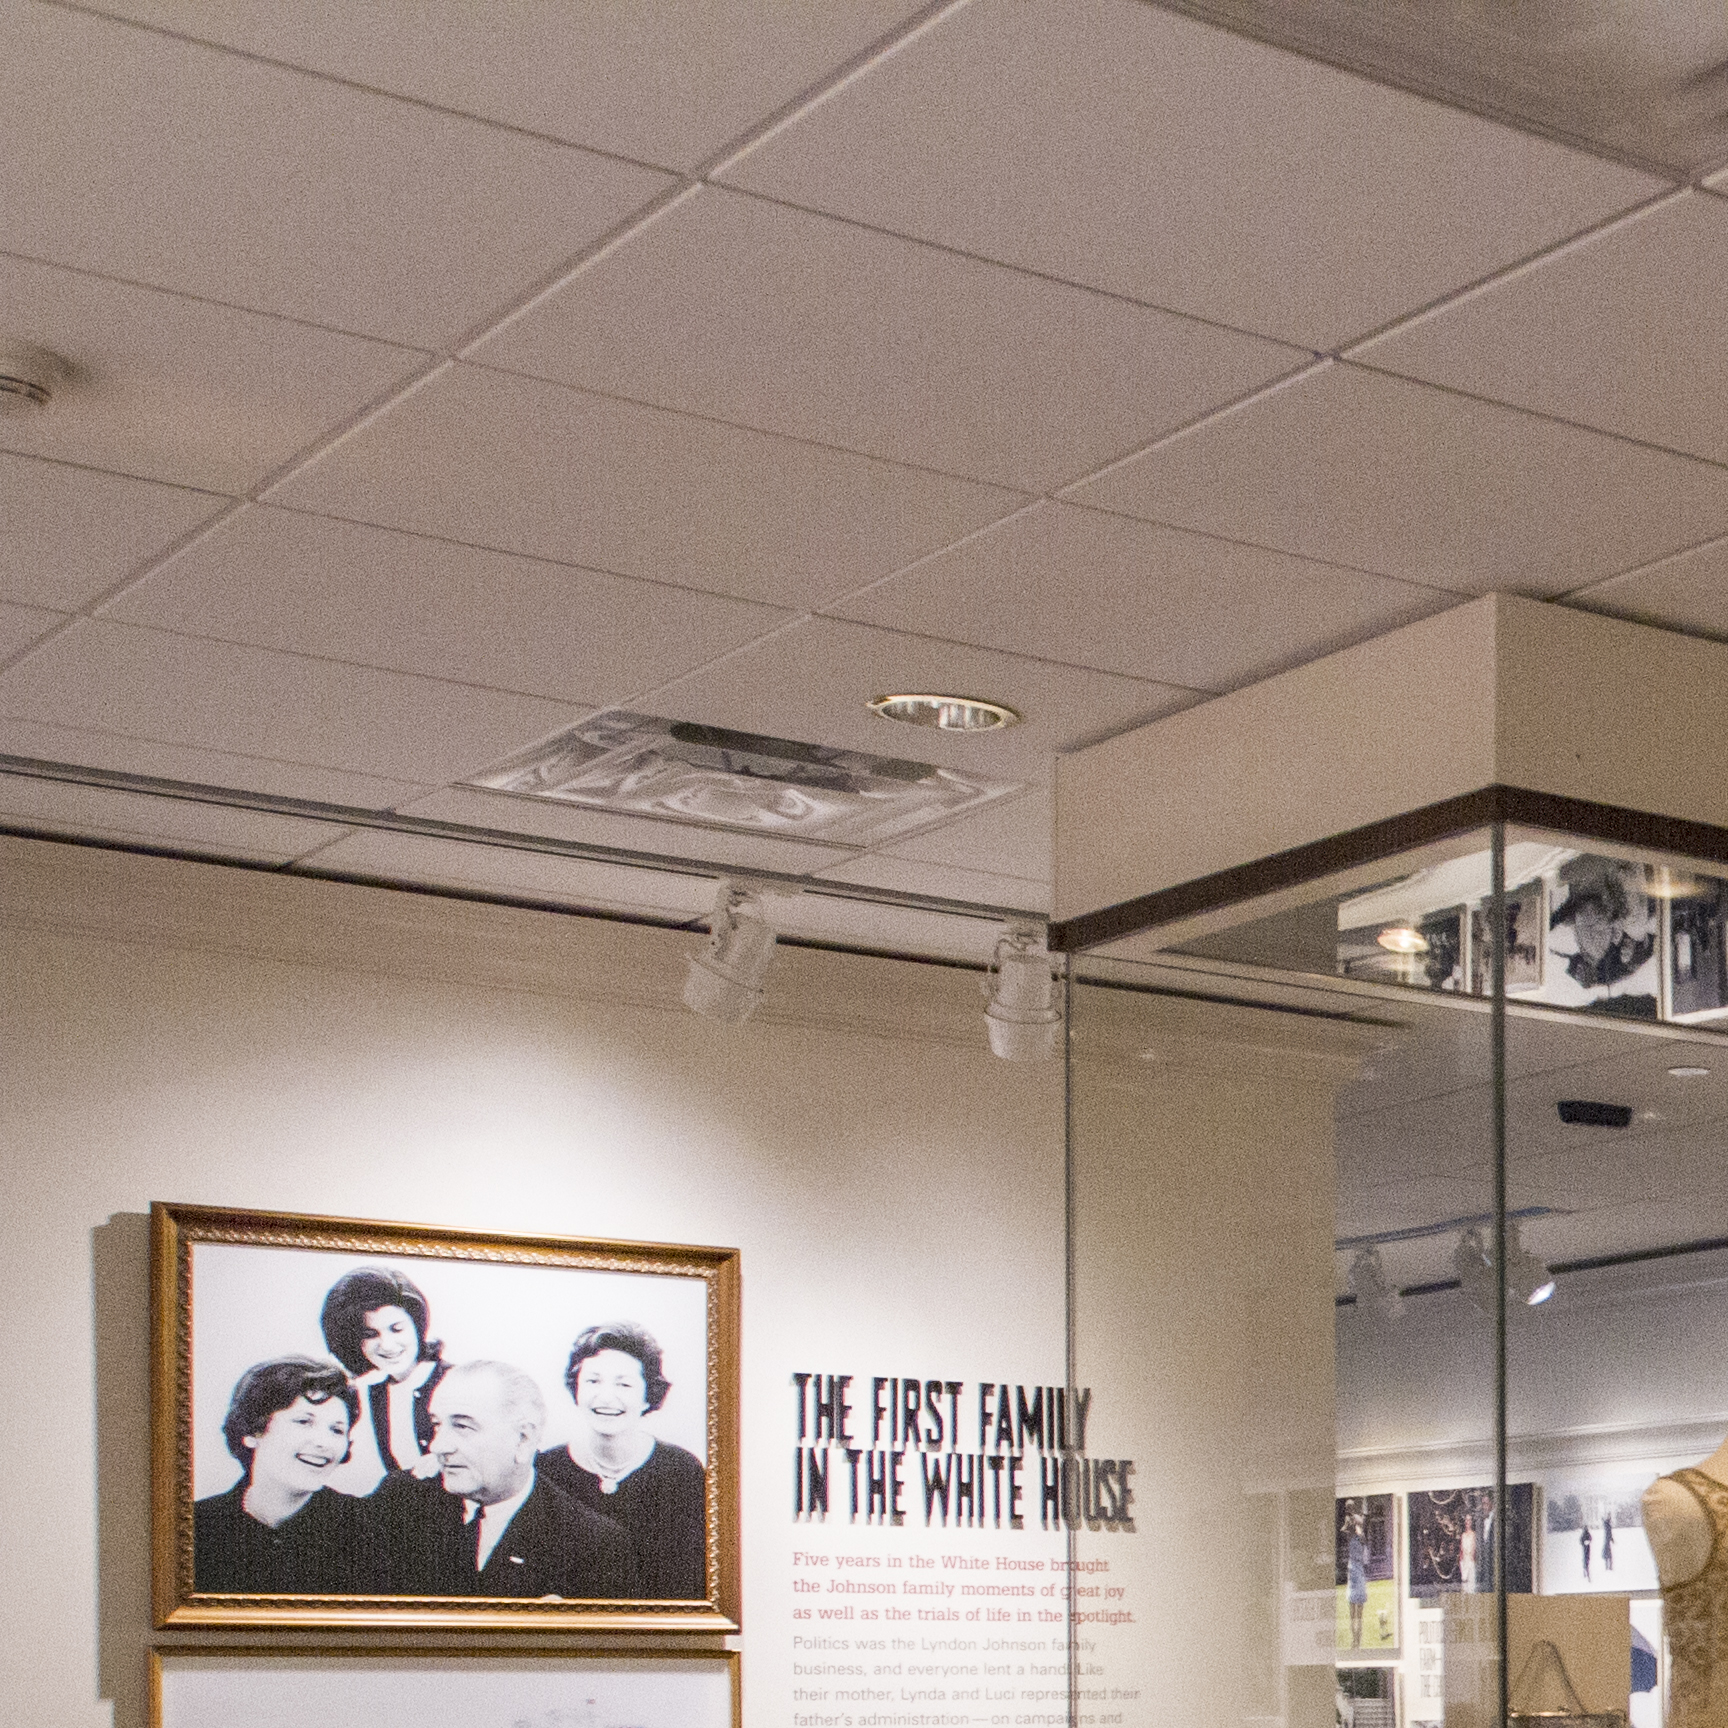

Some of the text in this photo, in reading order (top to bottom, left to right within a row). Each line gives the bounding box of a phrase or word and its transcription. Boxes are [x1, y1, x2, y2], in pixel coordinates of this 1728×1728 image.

[793, 1372, 1092, 1454] THE FIRST FAMILY
[793, 1447, 1137, 1533] IN THE WHITE HOUSE
[793, 1552, 829, 1567] Five
[835, 1555, 881, 1570] years
[887, 1554, 903, 1568] in
[909, 1555, 935, 1569] the
[942, 1555, 990, 1570] White
[996, 1557, 1045, 1571] House
[793, 1579, 1125, 1600] the Johnson family moments of geat joy
[793, 1608, 811, 1619] as
[818, 1606, 854, 1620] well
[860, 1609, 879, 1620] as
[885, 1607, 911, 1620] the
[918, 1608, 960, 1621] trials
[965, 1608, 980, 1622] of
[986, 1608, 1011, 1622] life
[1017, 1609, 1032, 1622] in
[1038, 1610, 1062, 1622] the
[793, 1636, 849, 1650] Politics
[855, 1639, 886, 1650] was
[892, 1638, 915, 1650] the
[921, 1637, 976, 1653] Lyndon
[982, 1638, 1046, 1651] Johnson
[793, 1662, 867, 1677] business,
[873, 1662, 903, 1675] and
[908, 1664, 978, 1678] everyone
[984, 1663, 1011, 1675] lent
[1016, 1665, 1025, 1675] a
[1078, 1663, 1104, 1676] Like
[793, 1688, 829, 1701] their
[835, 1689, 895, 1703] mother,
[901, 1688, 946, 1703] Lynda
[952, 1688, 979, 1700] and
[985, 1688, 1016, 1700] Luci
[1111, 1689, 1141, 1700] their
[793, 1713, 853, 1727] father's
[1100, 1713, 1123, 1724] and
